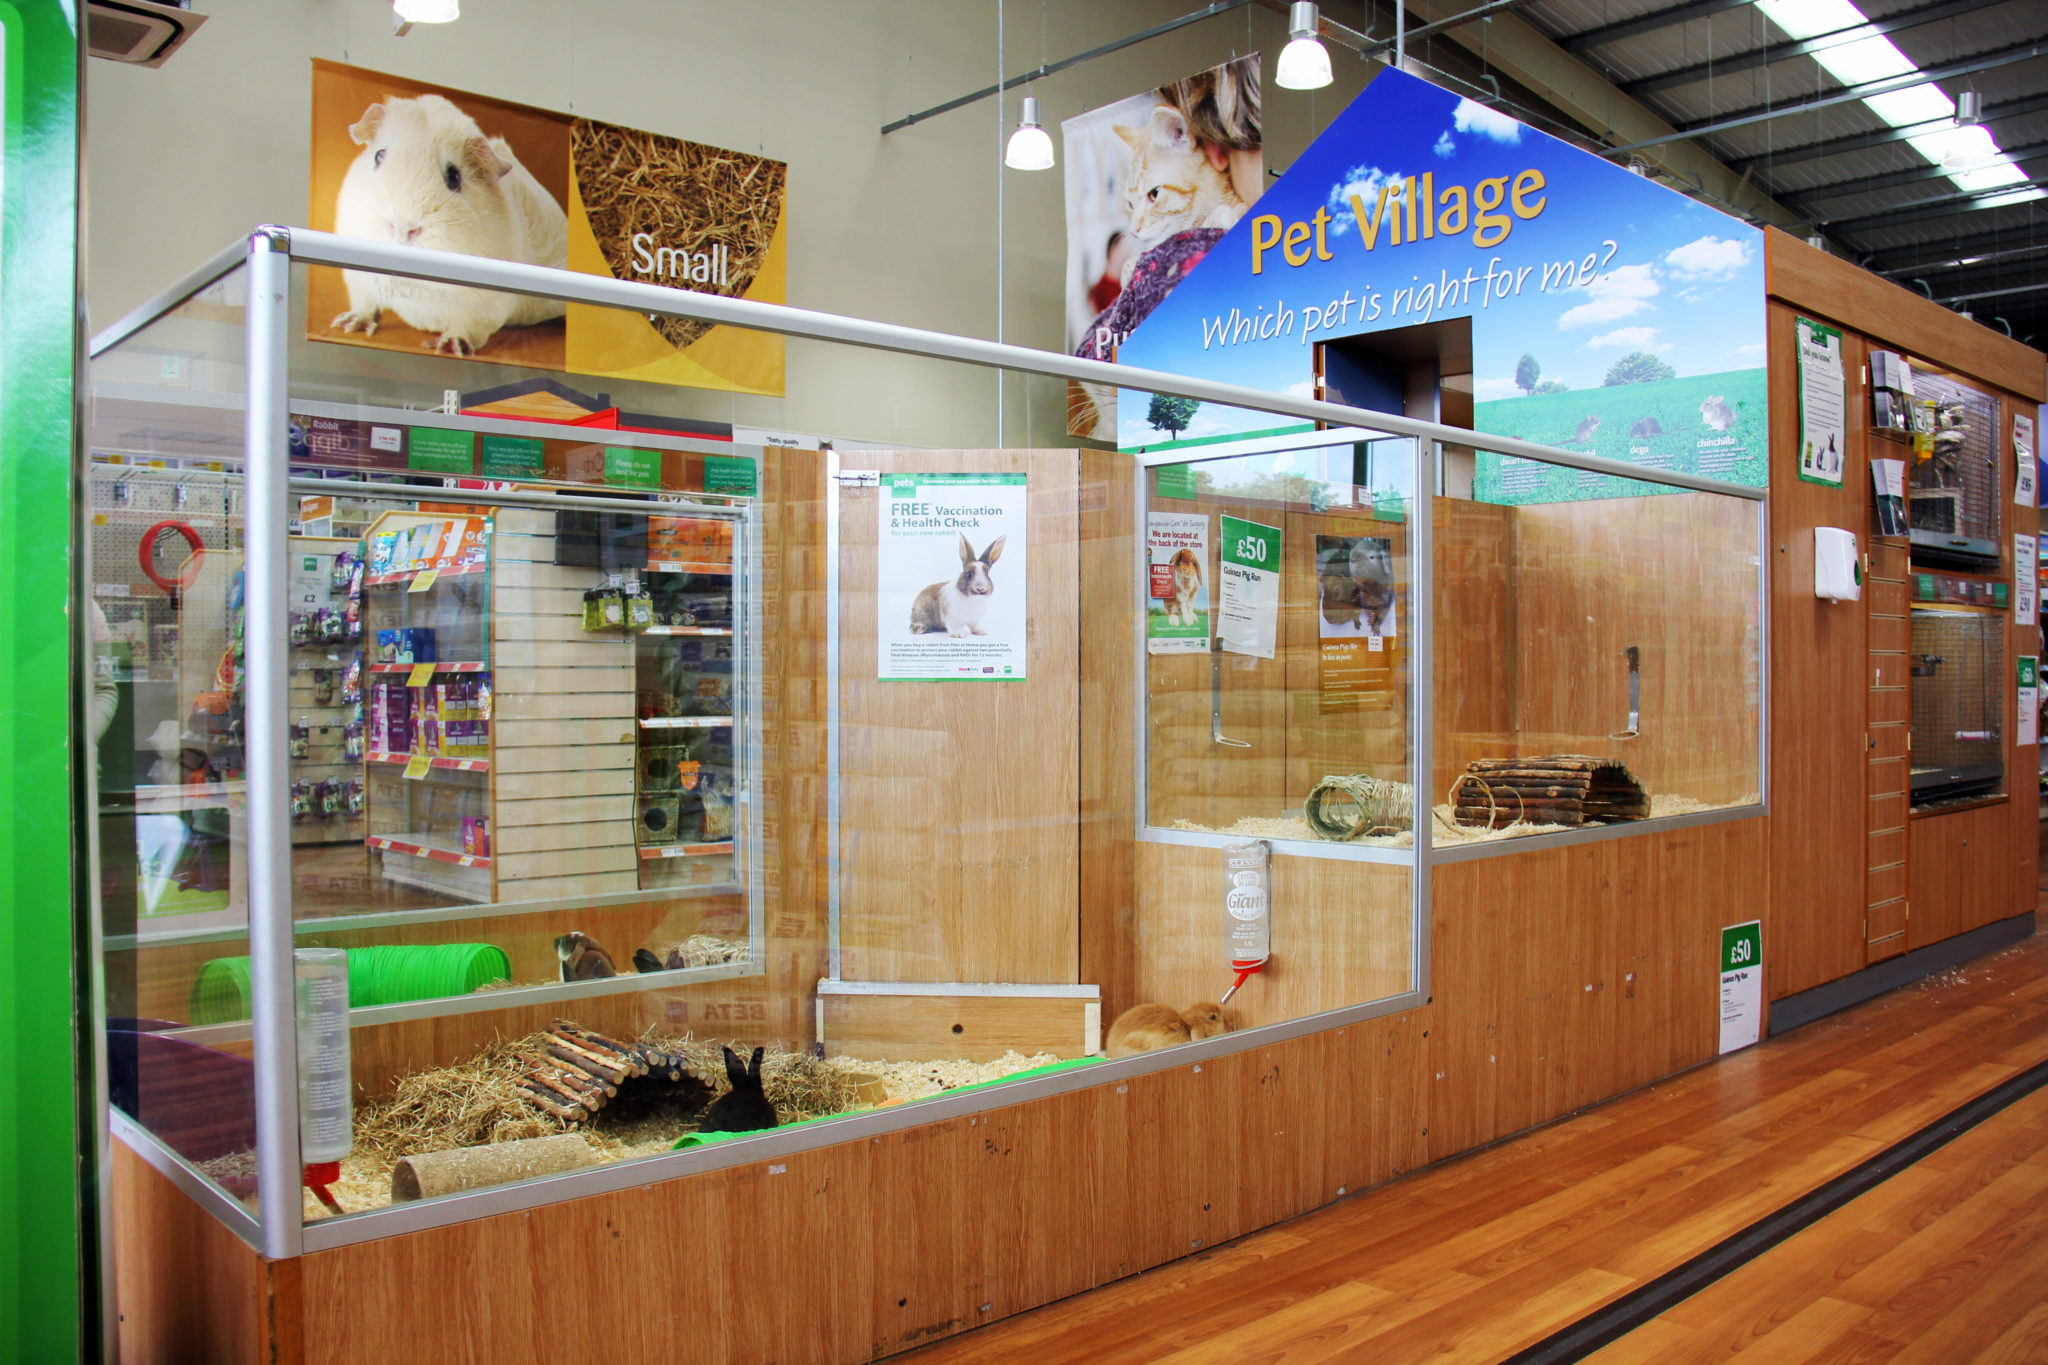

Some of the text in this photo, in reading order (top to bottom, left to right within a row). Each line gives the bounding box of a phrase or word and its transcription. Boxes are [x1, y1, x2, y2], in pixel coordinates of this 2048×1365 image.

[1252, 168, 1547, 276] Pet Village
[631, 232, 729, 287] Small
[1203, 239, 1619, 350] Which pet is right for me?
[313, 419, 339, 431] Rabbit
[1696, 436, 1736, 449] chinchilla
[1630, 445, 1650, 456] degu
[615, 459, 632, 467] Please
[894, 477, 914, 488] pets
[935, 506, 1003, 517] Vaccination
[890, 517, 980, 528] & Health Check
[1152, 530, 1161, 538] We
[1172, 531, 1192, 540] located
[1148, 539, 1158, 547] the
[1158, 539, 1172, 548] back
[1173, 540, 1179, 548] of
[1179, 540, 1188, 549] the
[1236, 535, 1267, 563] £50
[1153, 566, 1170, 574] FREE
[1223, 566, 1262, 582] Guinea Pig Run
[304, 594, 316, 603] £2
[1327, 653, 1336, 661] live
[1730, 938, 1752, 964] £50
[1722, 975, 1734, 984] Guinea
